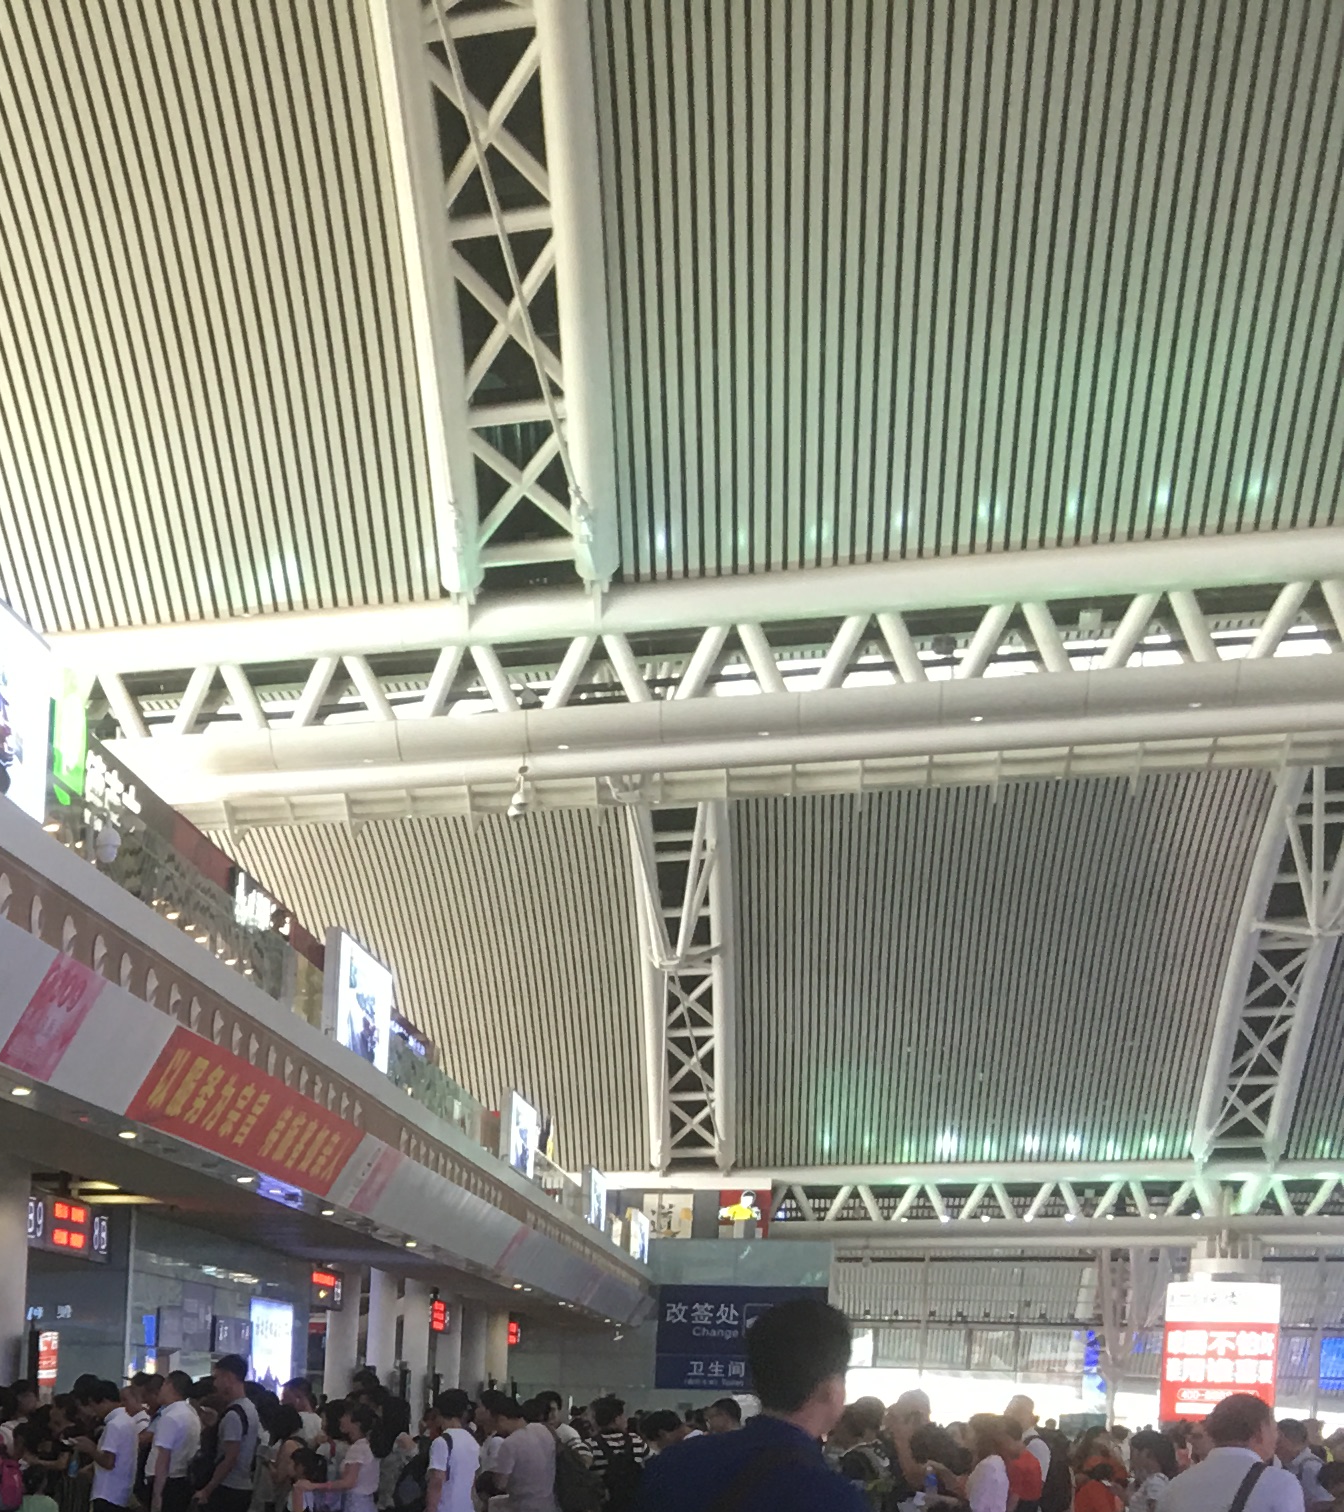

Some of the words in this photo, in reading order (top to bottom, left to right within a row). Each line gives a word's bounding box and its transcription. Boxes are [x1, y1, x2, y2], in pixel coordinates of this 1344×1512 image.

[665, 1302, 740, 1326] 改签处
[692, 1326, 739, 1340] Change
[687, 1360, 746, 1378] 卫生间
